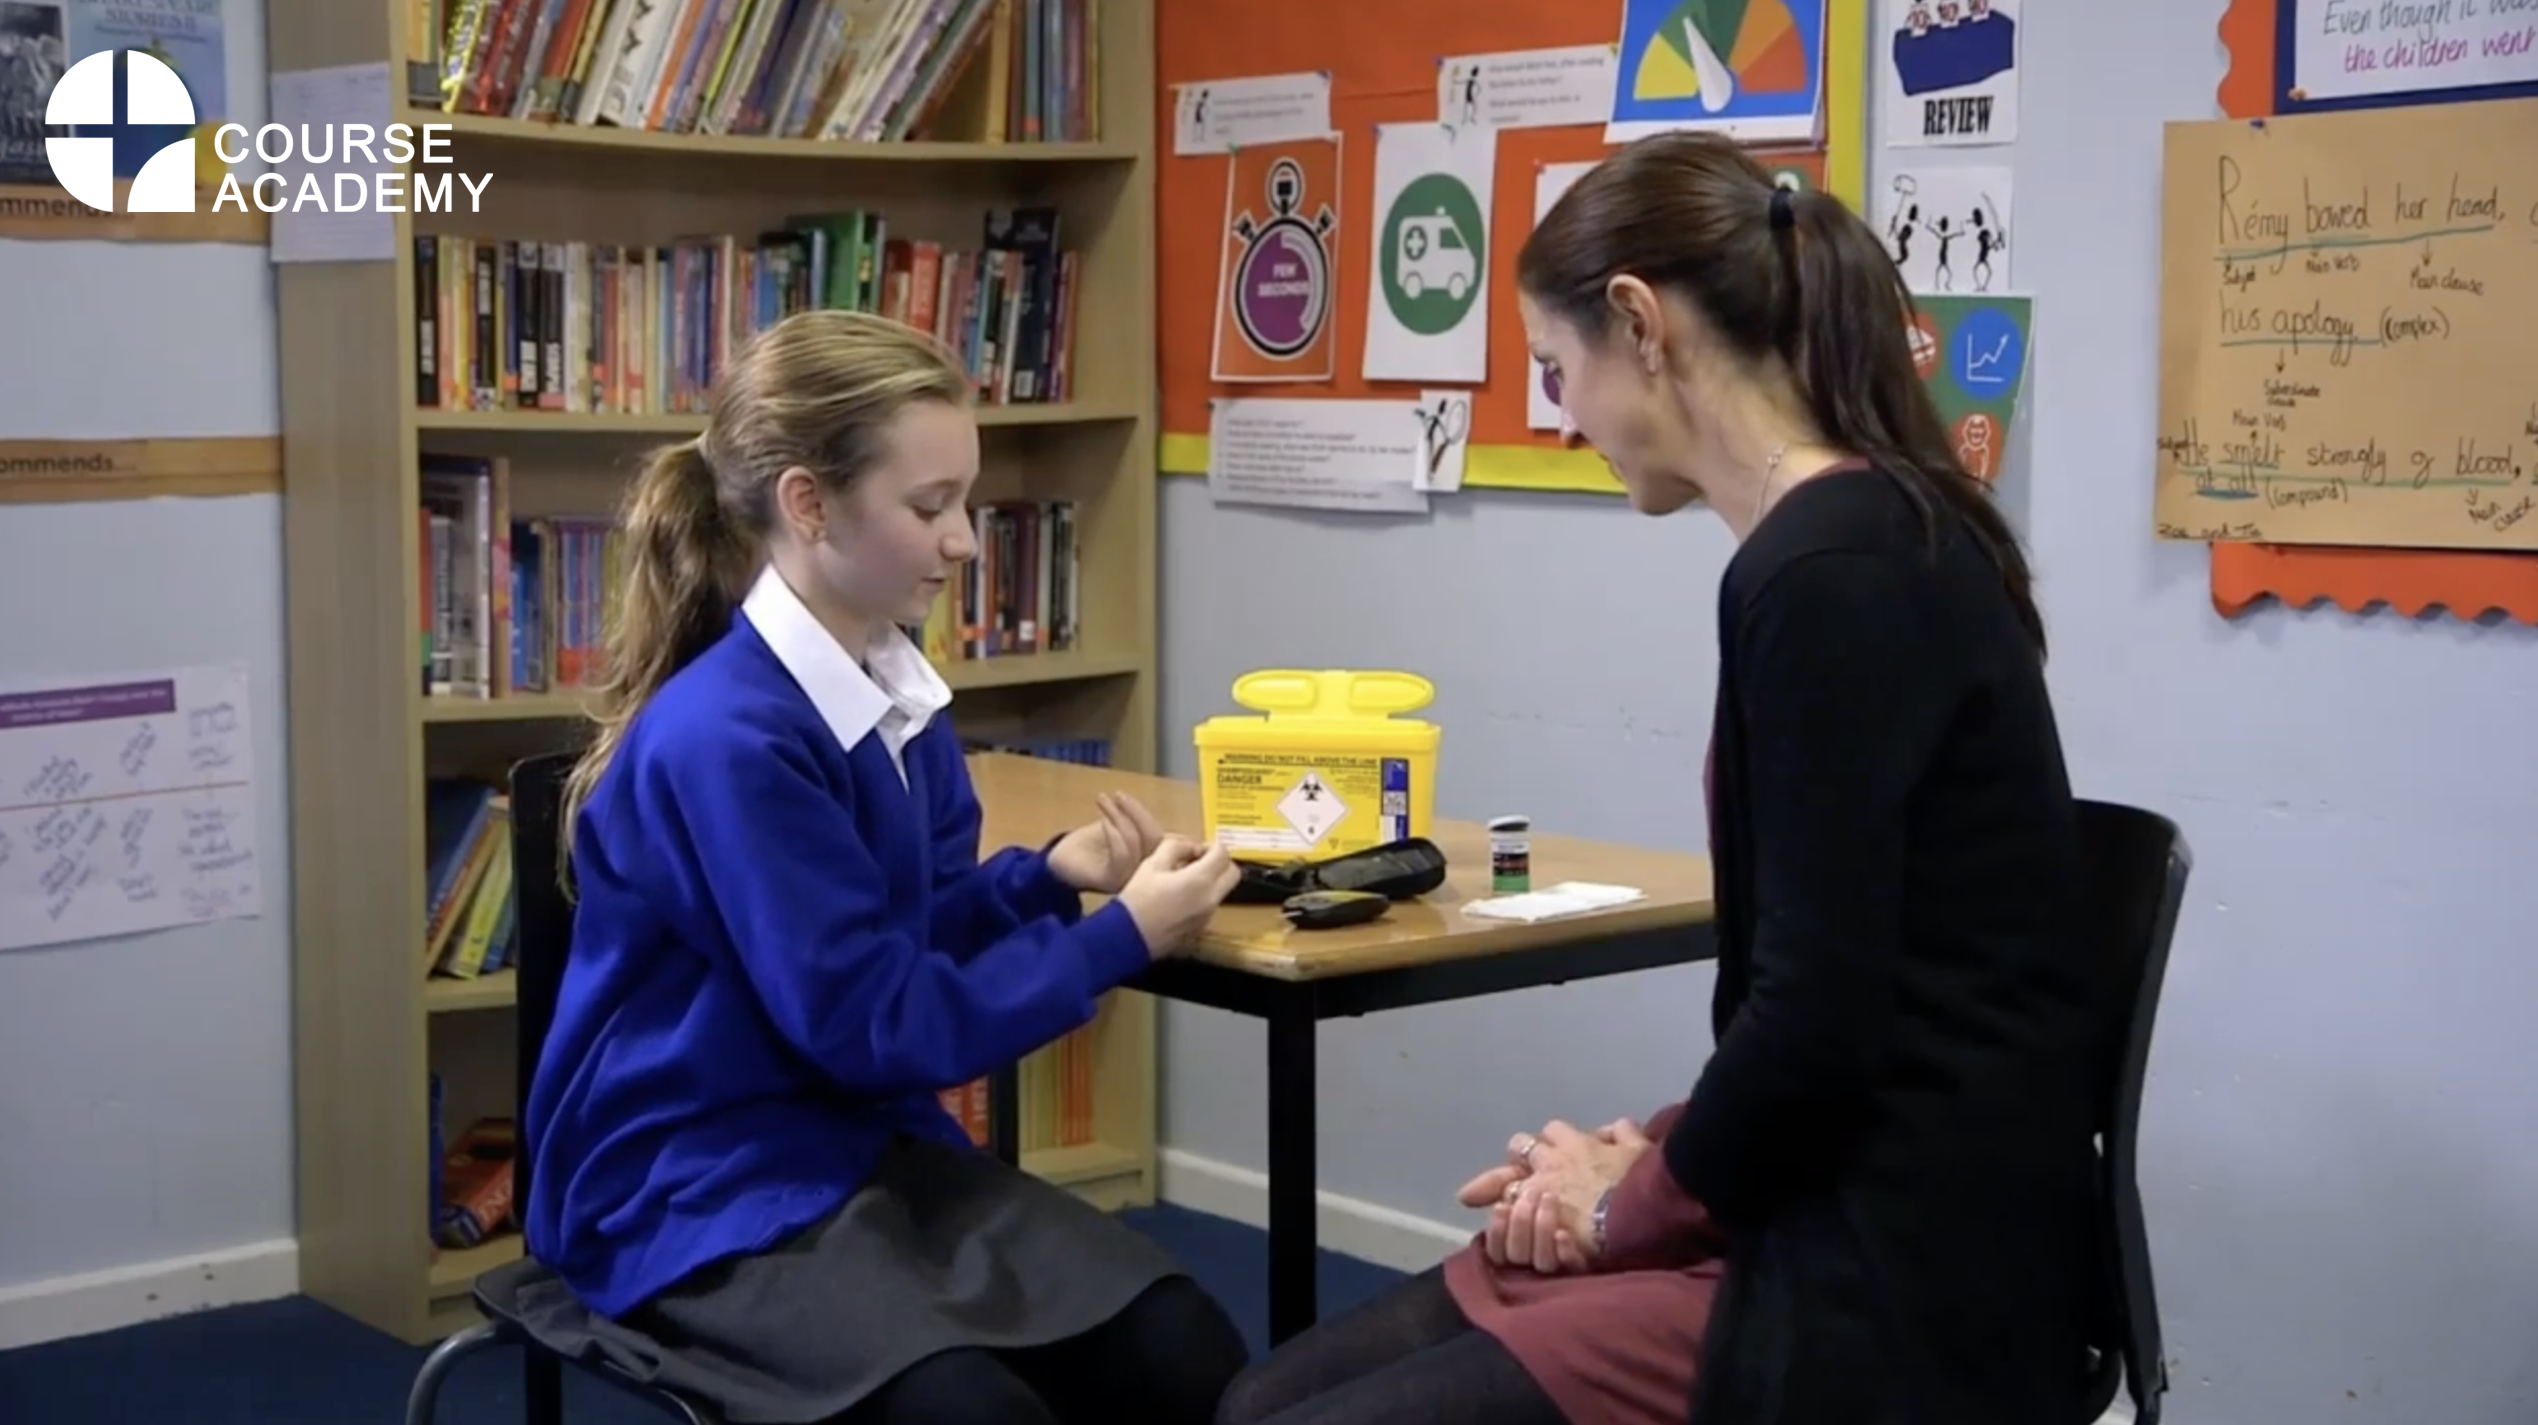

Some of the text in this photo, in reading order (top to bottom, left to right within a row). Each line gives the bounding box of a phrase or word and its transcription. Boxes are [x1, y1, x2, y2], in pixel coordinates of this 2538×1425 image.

[2324, 0, 2371, 34] Even
[2380, 0, 2450, 43] though
[2345, 26, 2537, 73] the children went
[1923, 95, 1994, 136] REVIEW
[2219, 155, 2288, 276] Rémy
[2304, 176, 2372, 233] bowed
[2396, 182, 2428, 224] her
[1273, 264, 1297, 278] FEW
[2219, 289, 2261, 334] his
[2222, 432, 2285, 464] smelt
[2307, 436, 2387, 487] strongly
[1217, 774, 1262, 785] DANGER
